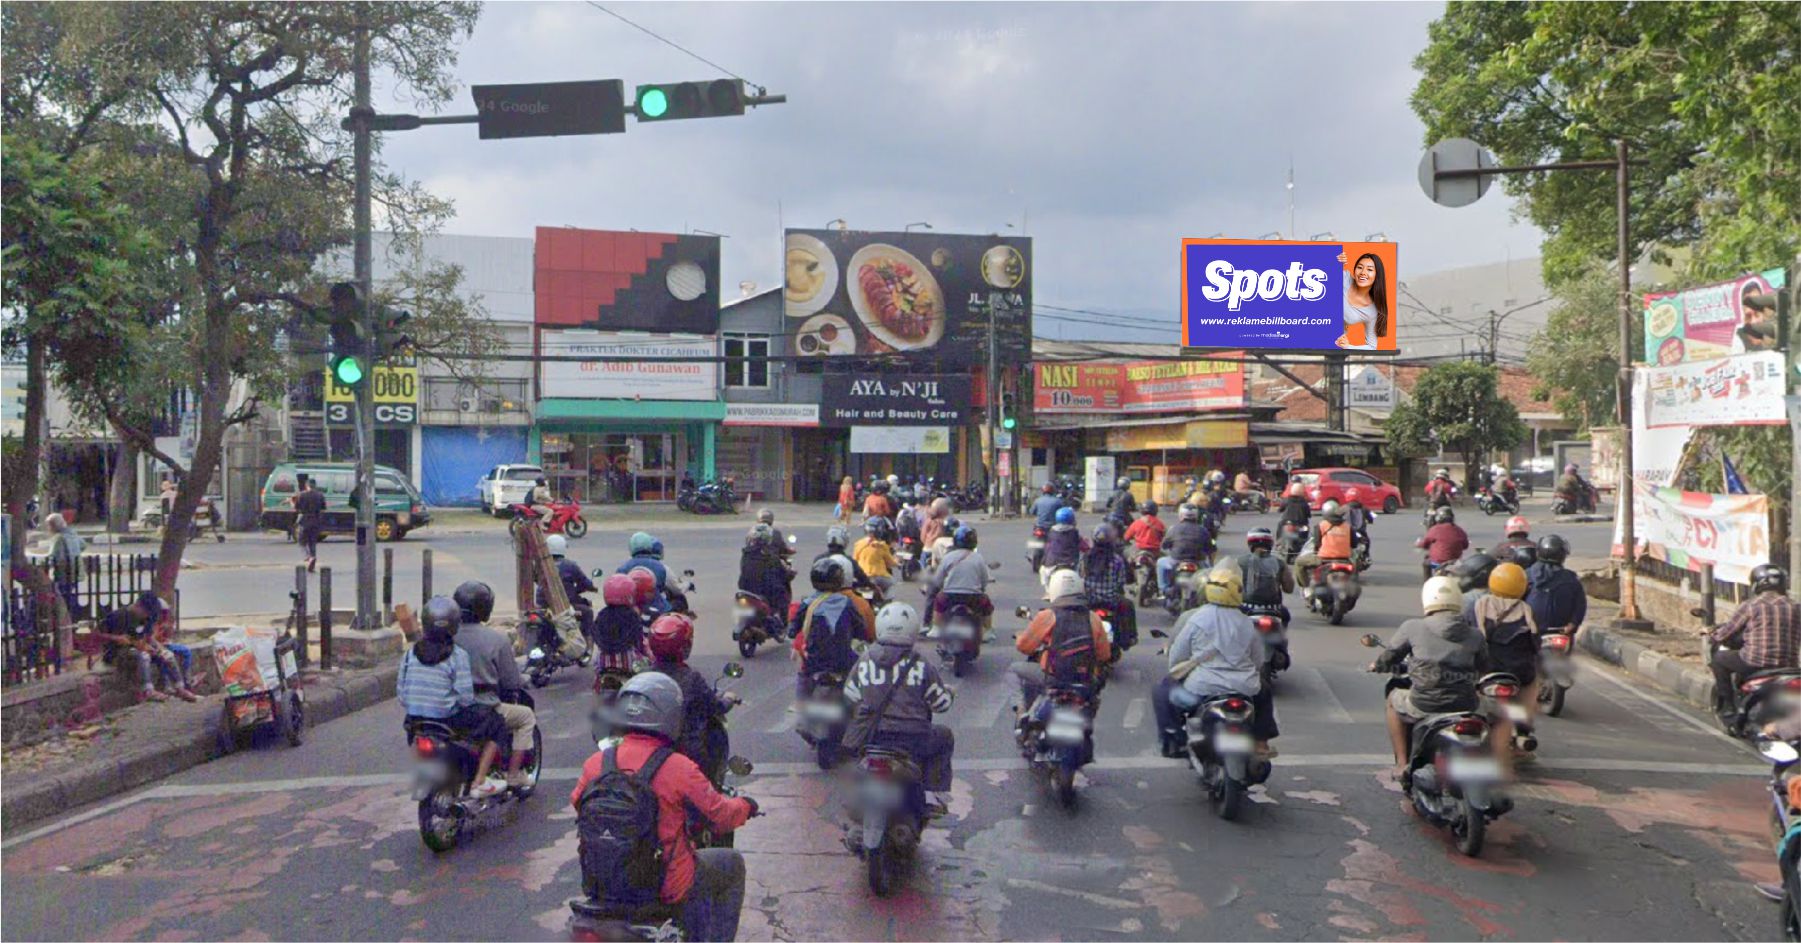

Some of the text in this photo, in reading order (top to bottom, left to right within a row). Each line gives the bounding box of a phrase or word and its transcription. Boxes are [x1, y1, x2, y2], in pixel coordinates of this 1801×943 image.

[1201, 260, 1328, 311] Spots
[1200, 317, 1332, 325] www.reklamebillboard.com
[569, 345, 616, 353] PRAKTEK
[618, 346, 658, 354] DOKTER
[580, 361, 701, 374] dr. Adib Gunawan
[1041, 365, 1079, 388] NASI
[850, 380, 886, 396] AYA
[890, 389, 900, 397] by
[329, 404, 347, 421] 3
[836, 409, 958, 420] Hair and Beauty Care
